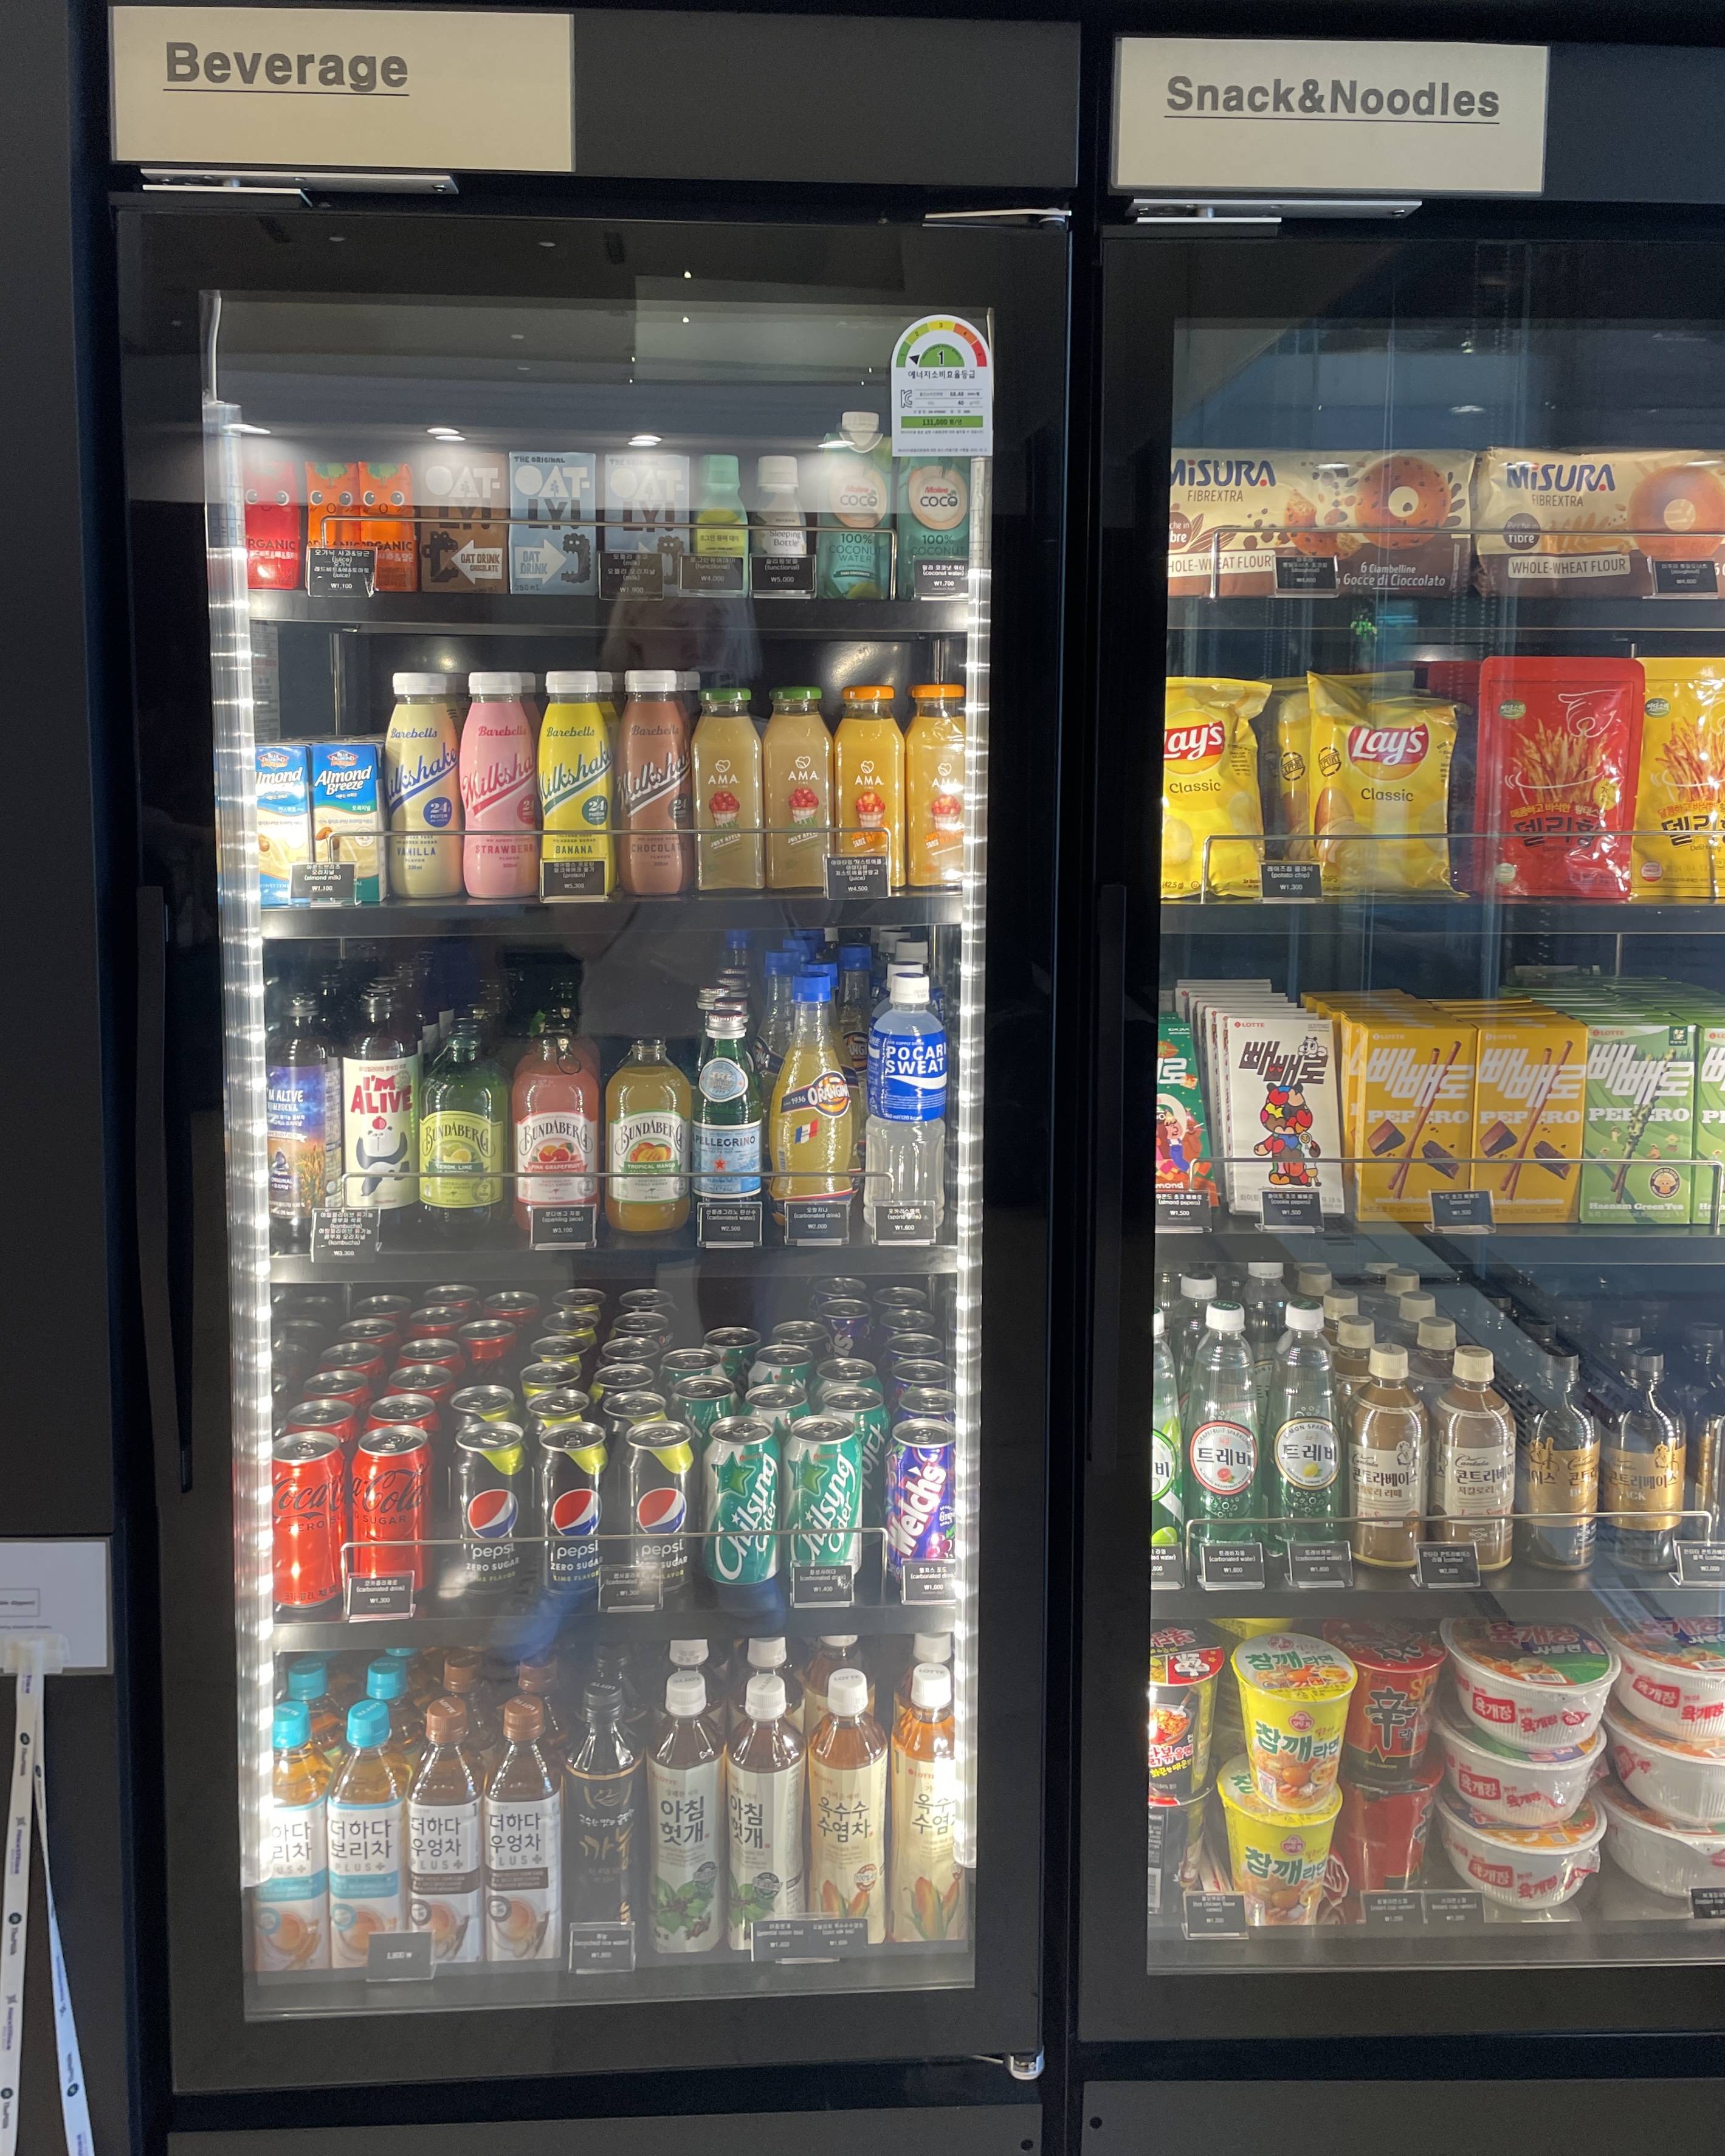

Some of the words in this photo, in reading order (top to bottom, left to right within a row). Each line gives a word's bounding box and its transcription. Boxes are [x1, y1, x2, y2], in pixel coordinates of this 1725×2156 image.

[166, 41, 408, 92] Beverage
[1167, 76, 1499, 117] Snack&Noodles
[938, 351, 943, 365] 1
[908, 370, 975, 379] 에너지소비효율등급
[1188, 490, 1244, 502] FIBREXTRA
[1532, 494, 1583, 507] FIBREXTRA
[769, 531, 801, 539] Sleeping
[841, 534, 872, 544] 100%
[923, 535, 954, 545] 100%
[1509, 534, 1534, 543] fibre
[523, 551, 540, 562] OAT
[830, 545, 882, 554] COCONUT
[912, 547, 963, 556] COCONUT
[461, 554, 475, 563] OAT
[477, 554, 500, 564] DRINK
[1512, 561, 1588, 575] WHOLE-WHEAT
[1591, 559, 1625, 572] FLOUR
[520, 562, 547, 574] DRINK
[1361, 562, 1367, 574] 6
[1369, 562, 1416, 574] Ciambelline
[1343, 573, 1376, 587] Gocce
[1377, 573, 1388, 585] di
[1390, 574, 1445, 587] Cioccolato
[390, 728, 437, 738] Barebells
[478, 726, 526, 737] Barebells
[546, 726, 594, 737] Barebells
[632, 725, 679, 735] Barebells
[1352, 726, 1425, 766] Lay's
[1281, 757, 1304, 776] EXPORT
[314, 766, 372, 787] Almond
[708, 774, 738, 784] AMA
[788, 771, 818, 780] AMA
[855, 776, 883, 785] AMA
[326, 780, 363, 795] Breeze
[1169, 779, 1221, 793] Classic
[1361, 788, 1414, 802] Classic
[632, 844, 686, 852] CHOCOLATE
[711, 837, 724, 848] JUST
[725, 833, 741, 843] APPLE
[397, 847, 436, 856] VANILLA
[556, 845, 593, 854] BANANA
[886, 1042, 946, 1060] POCARI
[886, 1058, 943, 1074] SWEAT
[1239, 1041, 1329, 1086] 빼빼로
[1366, 1049, 1475, 1107] 빼빼로
[1478, 1049, 1586, 1107] 빼빼로
[1587, 1044, 1695, 1105] 빼빼로
[351, 1085, 413, 1115] ALIVE
[1197, 1448, 1251, 1466] 트레비
[1282, 1444, 1337, 1462] 트레비
[1455, 1453, 1489, 1467] Cantata
[1352, 1467, 1418, 1487] 콘트라베이스
[363, 1515, 407, 1524] SUGAR
[472, 1543, 515, 1559] pepsi
[557, 1540, 599, 1559] pepsi
[642, 1540, 684, 1557] pepsi
[466, 1563, 489, 1571] ZERO
[492, 1557, 520, 1570] SUGAR
[551, 1563, 573, 1571] ZERO
[577, 1557, 604, 1570] SUGAR
[574, 1571, 599, 1580] FLAVOR
[1490, 1624, 1580, 1645] 육개장
[1642, 1617, 1722, 1636] 육개장
[1245, 1651, 1335, 1670] 참깨라면
[1636, 1682, 1678, 1705] 육개장
[1473, 1696, 1514, 1720] 육개장
[1365, 1687, 1417, 1751] 辛
[1256, 1720, 1338, 1763] 참깨라면
[1460, 1773, 1498, 1797] 육개장
[661, 1796, 704, 1823] 아침
[731, 1795, 763, 1826] 아침
[818, 1796, 870, 1822] 옥수수
[331, 1820, 391, 1839] 더하다
[411, 1817, 461, 1836] 더하다
[489, 1813, 540, 1831] 더하다
[817, 1817, 871, 1842] 수염차
[660, 1820, 704, 1845] 헛개
[331, 1839, 392, 1859] 보리차
[412, 1839, 461, 1857] 우엉차
[489, 1833, 541, 1853] 우엉차
[335, 1863, 371, 1872] PLUS
[1245, 1845, 1327, 1884] 참깨라면
[1471, 1862, 1510, 1886] 육개장
